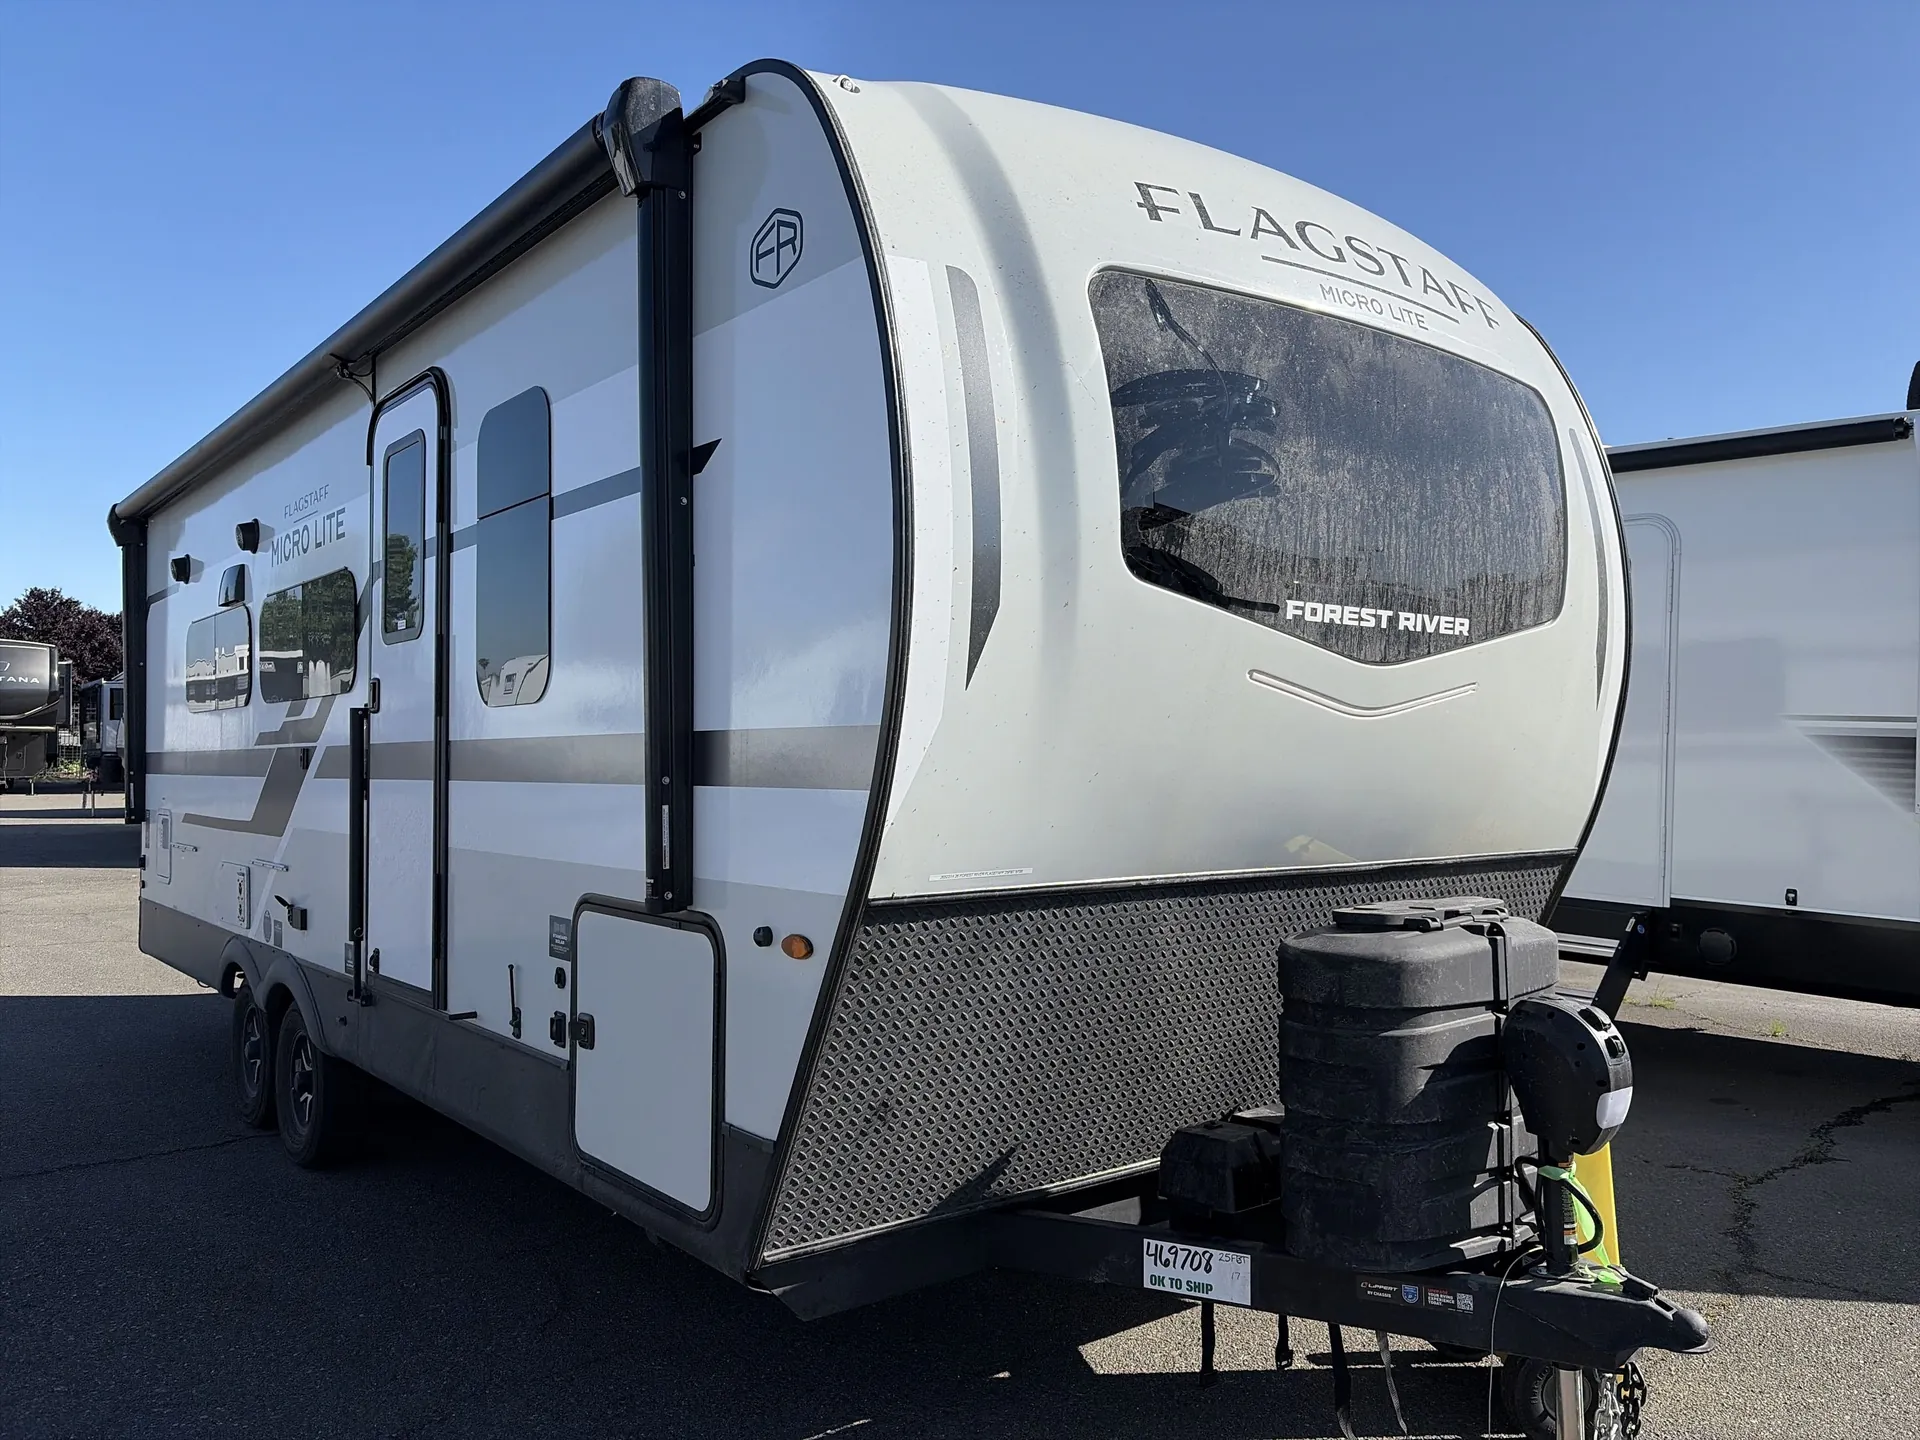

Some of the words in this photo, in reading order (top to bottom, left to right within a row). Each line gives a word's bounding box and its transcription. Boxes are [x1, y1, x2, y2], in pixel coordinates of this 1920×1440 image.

[1133, 181, 1501, 330] FLAGSTAFF
[1319, 283, 1384, 316] MICRO
[1388, 303, 1429, 331] LITE
[284, 483, 330, 520] FLAGSTAFF
[271, 524, 311, 568] MICRO
[314, 507, 346, 550] LITE
[1285, 599, 1394, 629] FOREST
[1398, 611, 1471, 637] RIVER
[1146, 1241, 1214, 1274] 469708
[1149, 1274, 1166, 1287] OK
[1168, 1277, 1183, 1290] TO
[1186, 1280, 1214, 1295] SHIP
[1428, 1296, 1455, 1304] EXPERIENCE
